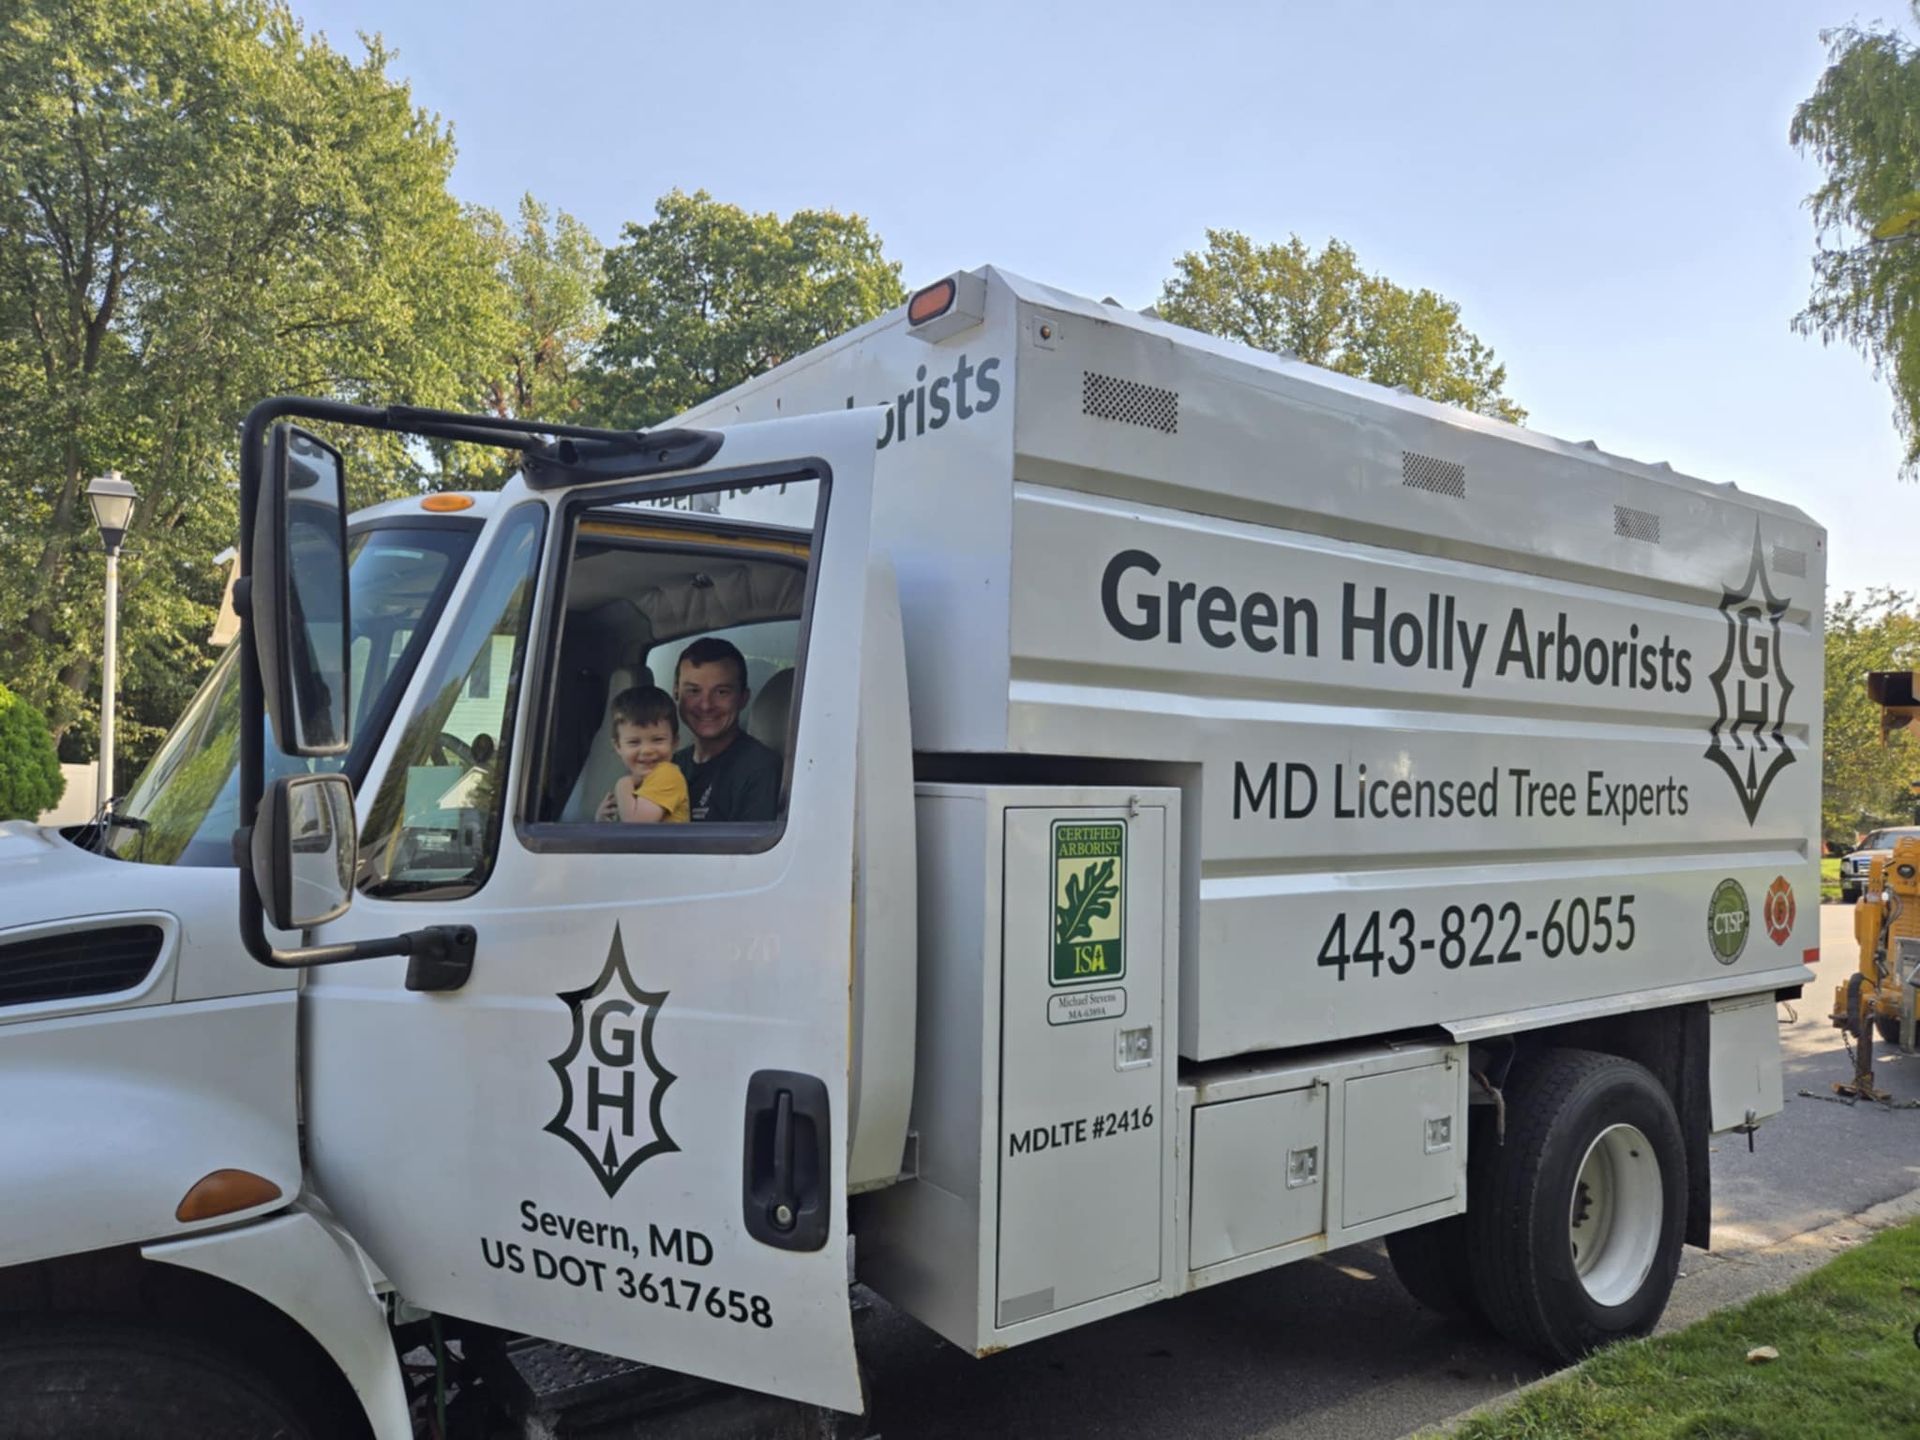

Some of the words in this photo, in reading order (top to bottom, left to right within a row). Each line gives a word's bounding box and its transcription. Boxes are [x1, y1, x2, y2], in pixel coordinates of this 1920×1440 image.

[1101, 549, 1319, 658] Green
[1342, 582, 1488, 688] Holly
[1495, 608, 1692, 693] Arborists
[1739, 606, 1769, 679] G
[1233, 761, 1318, 820] MD
[1334, 763, 1499, 819] Licensed
[1508, 768, 1577, 818] Tree
[1586, 771, 1689, 826] Experts
[1057, 827, 1121, 841] CERTIFIED
[1058, 841, 1120, 856] ARBORIST
[1317, 895, 1636, 981] 443-822-6055
[1713, 911, 1745, 935] CTSP
[1074, 944, 1107, 974] ISA
[588, 999, 636, 1067] G
[1058, 994, 1088, 1008] Michael
[1089, 993, 1117, 1005] Stevens
[587, 1066, 635, 1136] H
[1009, 1119, 1087, 1157] MDLTE
[1093, 1105, 1154, 1139] #2416
[520, 1200, 639, 1258] Severn,
[649, 1224, 714, 1266] MD
[481, 1237, 526, 1274] US
[533, 1249, 607, 1291] DOT
[616, 1266, 774, 1329] 3617658
